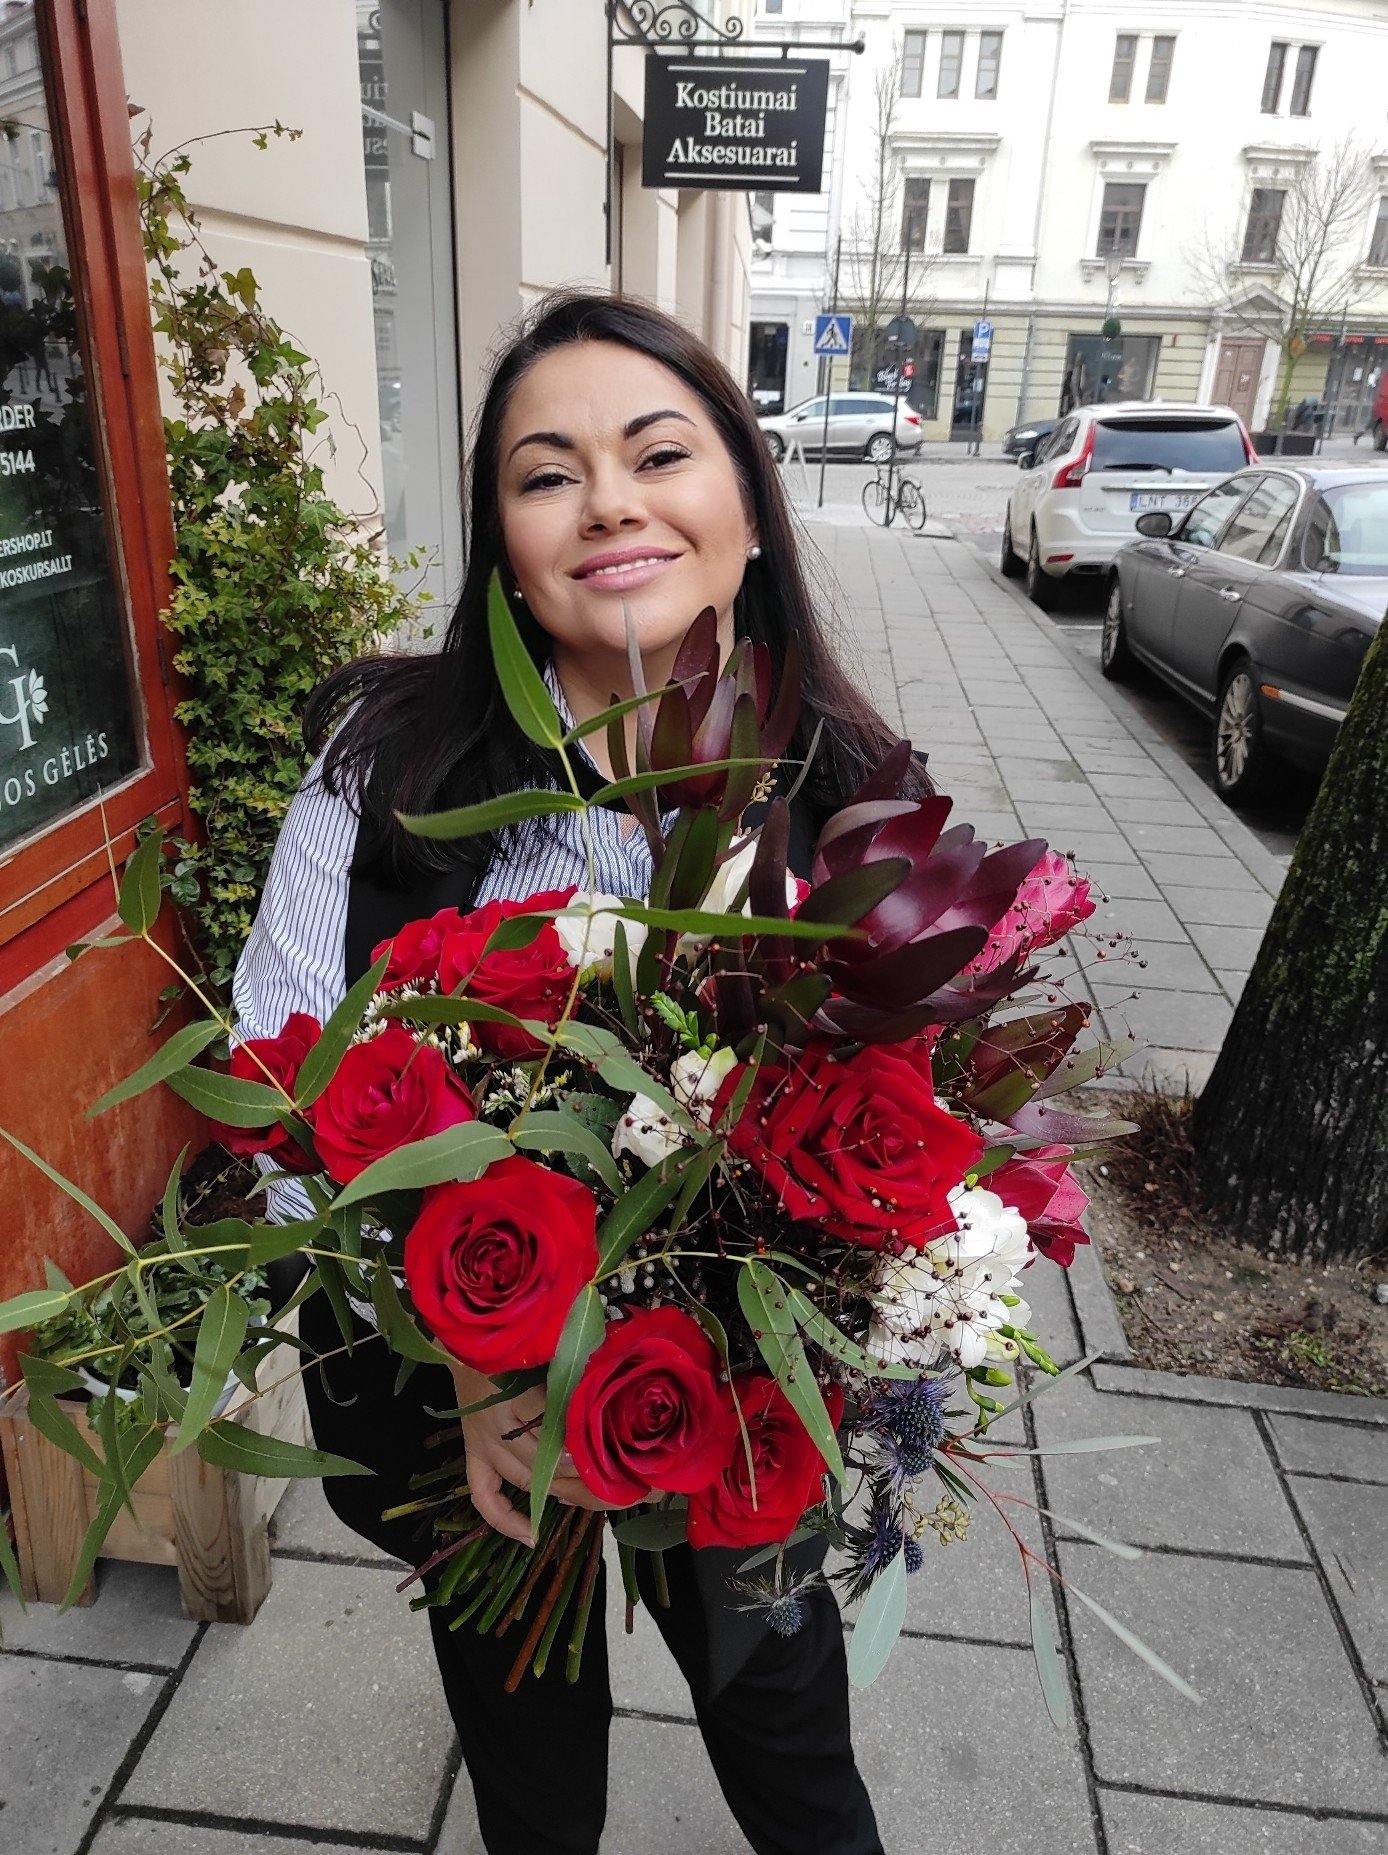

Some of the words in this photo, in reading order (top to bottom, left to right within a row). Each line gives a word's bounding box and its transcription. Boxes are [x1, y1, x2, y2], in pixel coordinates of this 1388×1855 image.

[676, 82, 797, 110] Kostiumai
[704, 111, 765, 137] Batai
[666, 137, 797, 166] Aksesuarai
[0, 404, 36, 432] DER
[0, 450, 36, 476] 5144
[0, 769, 36, 808] OS
[43, 732, 109, 785] GĖLĖS
